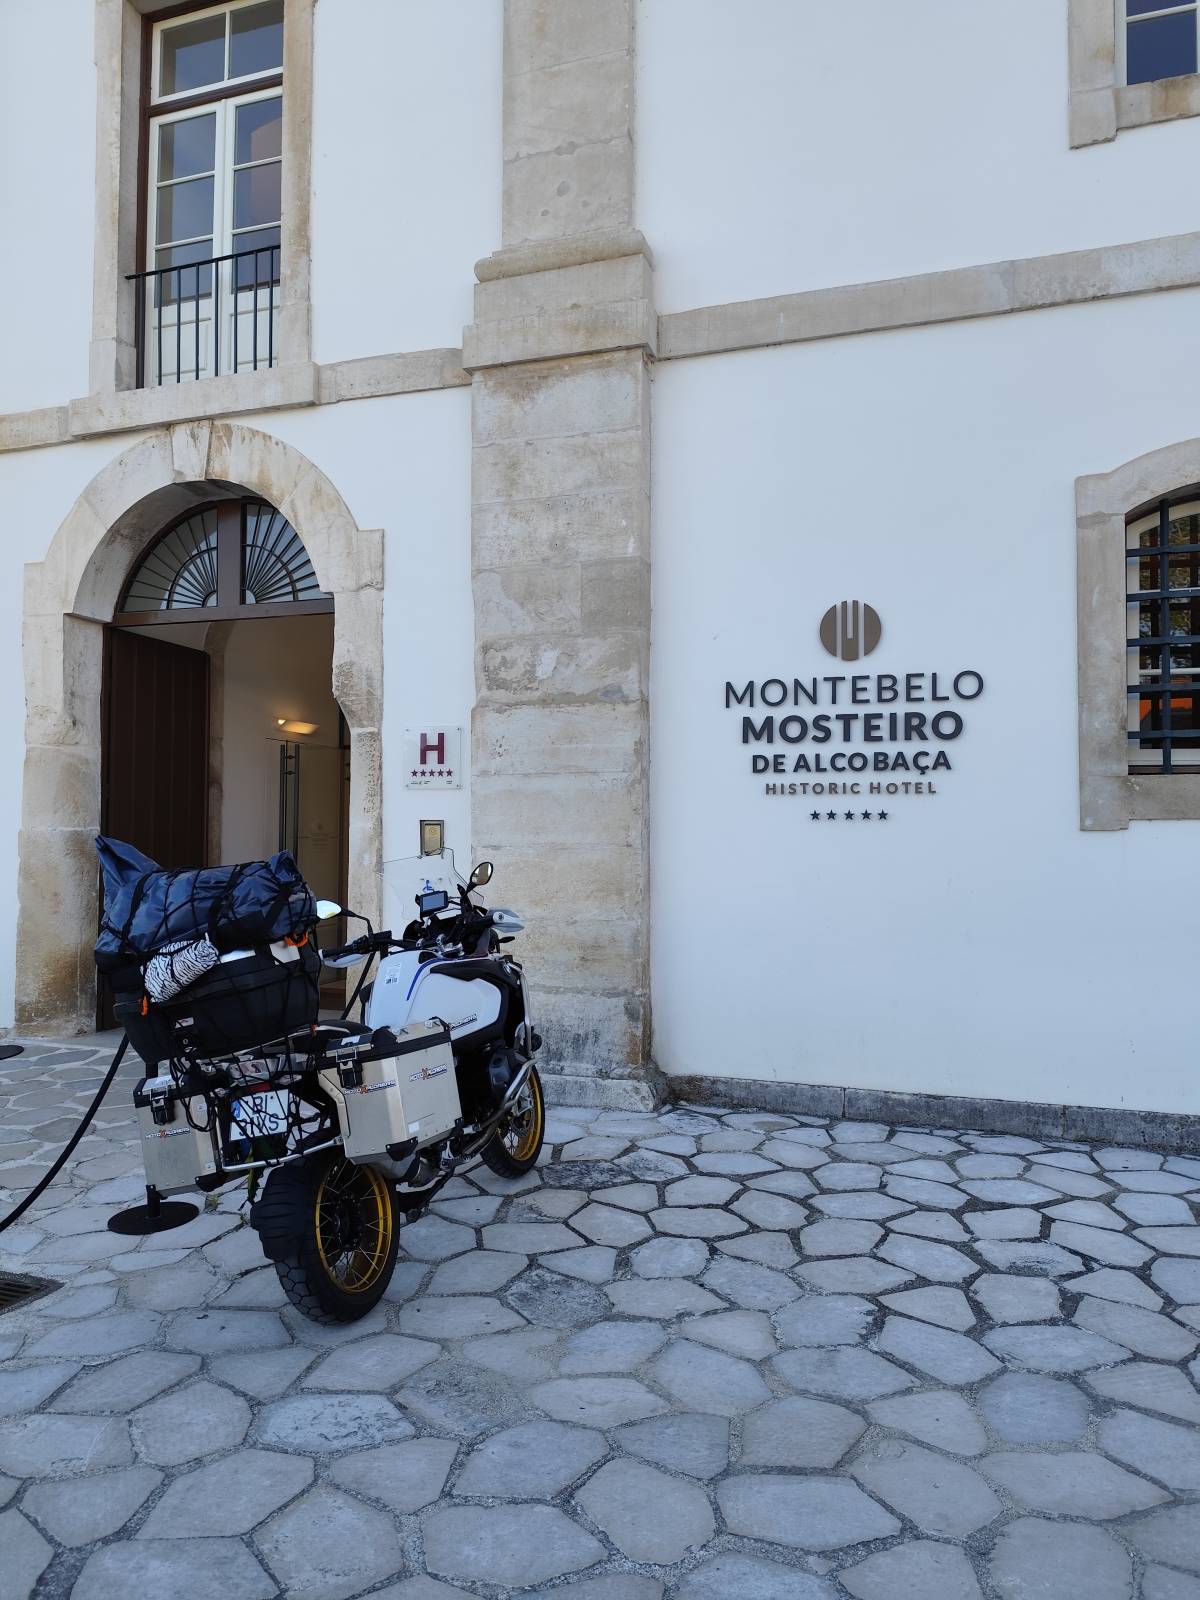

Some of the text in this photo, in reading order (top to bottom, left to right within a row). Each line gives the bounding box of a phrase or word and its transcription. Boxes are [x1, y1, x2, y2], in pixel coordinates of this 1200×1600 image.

[725, 670, 984, 708] MONTEBELO
[742, 711, 964, 744] MOSTEIRO
[420, 732, 445, 765] H
[752, 750, 952, 775] DE ALCOBAÇA
[765, 781, 937, 795] HISTORIC HOTEL
